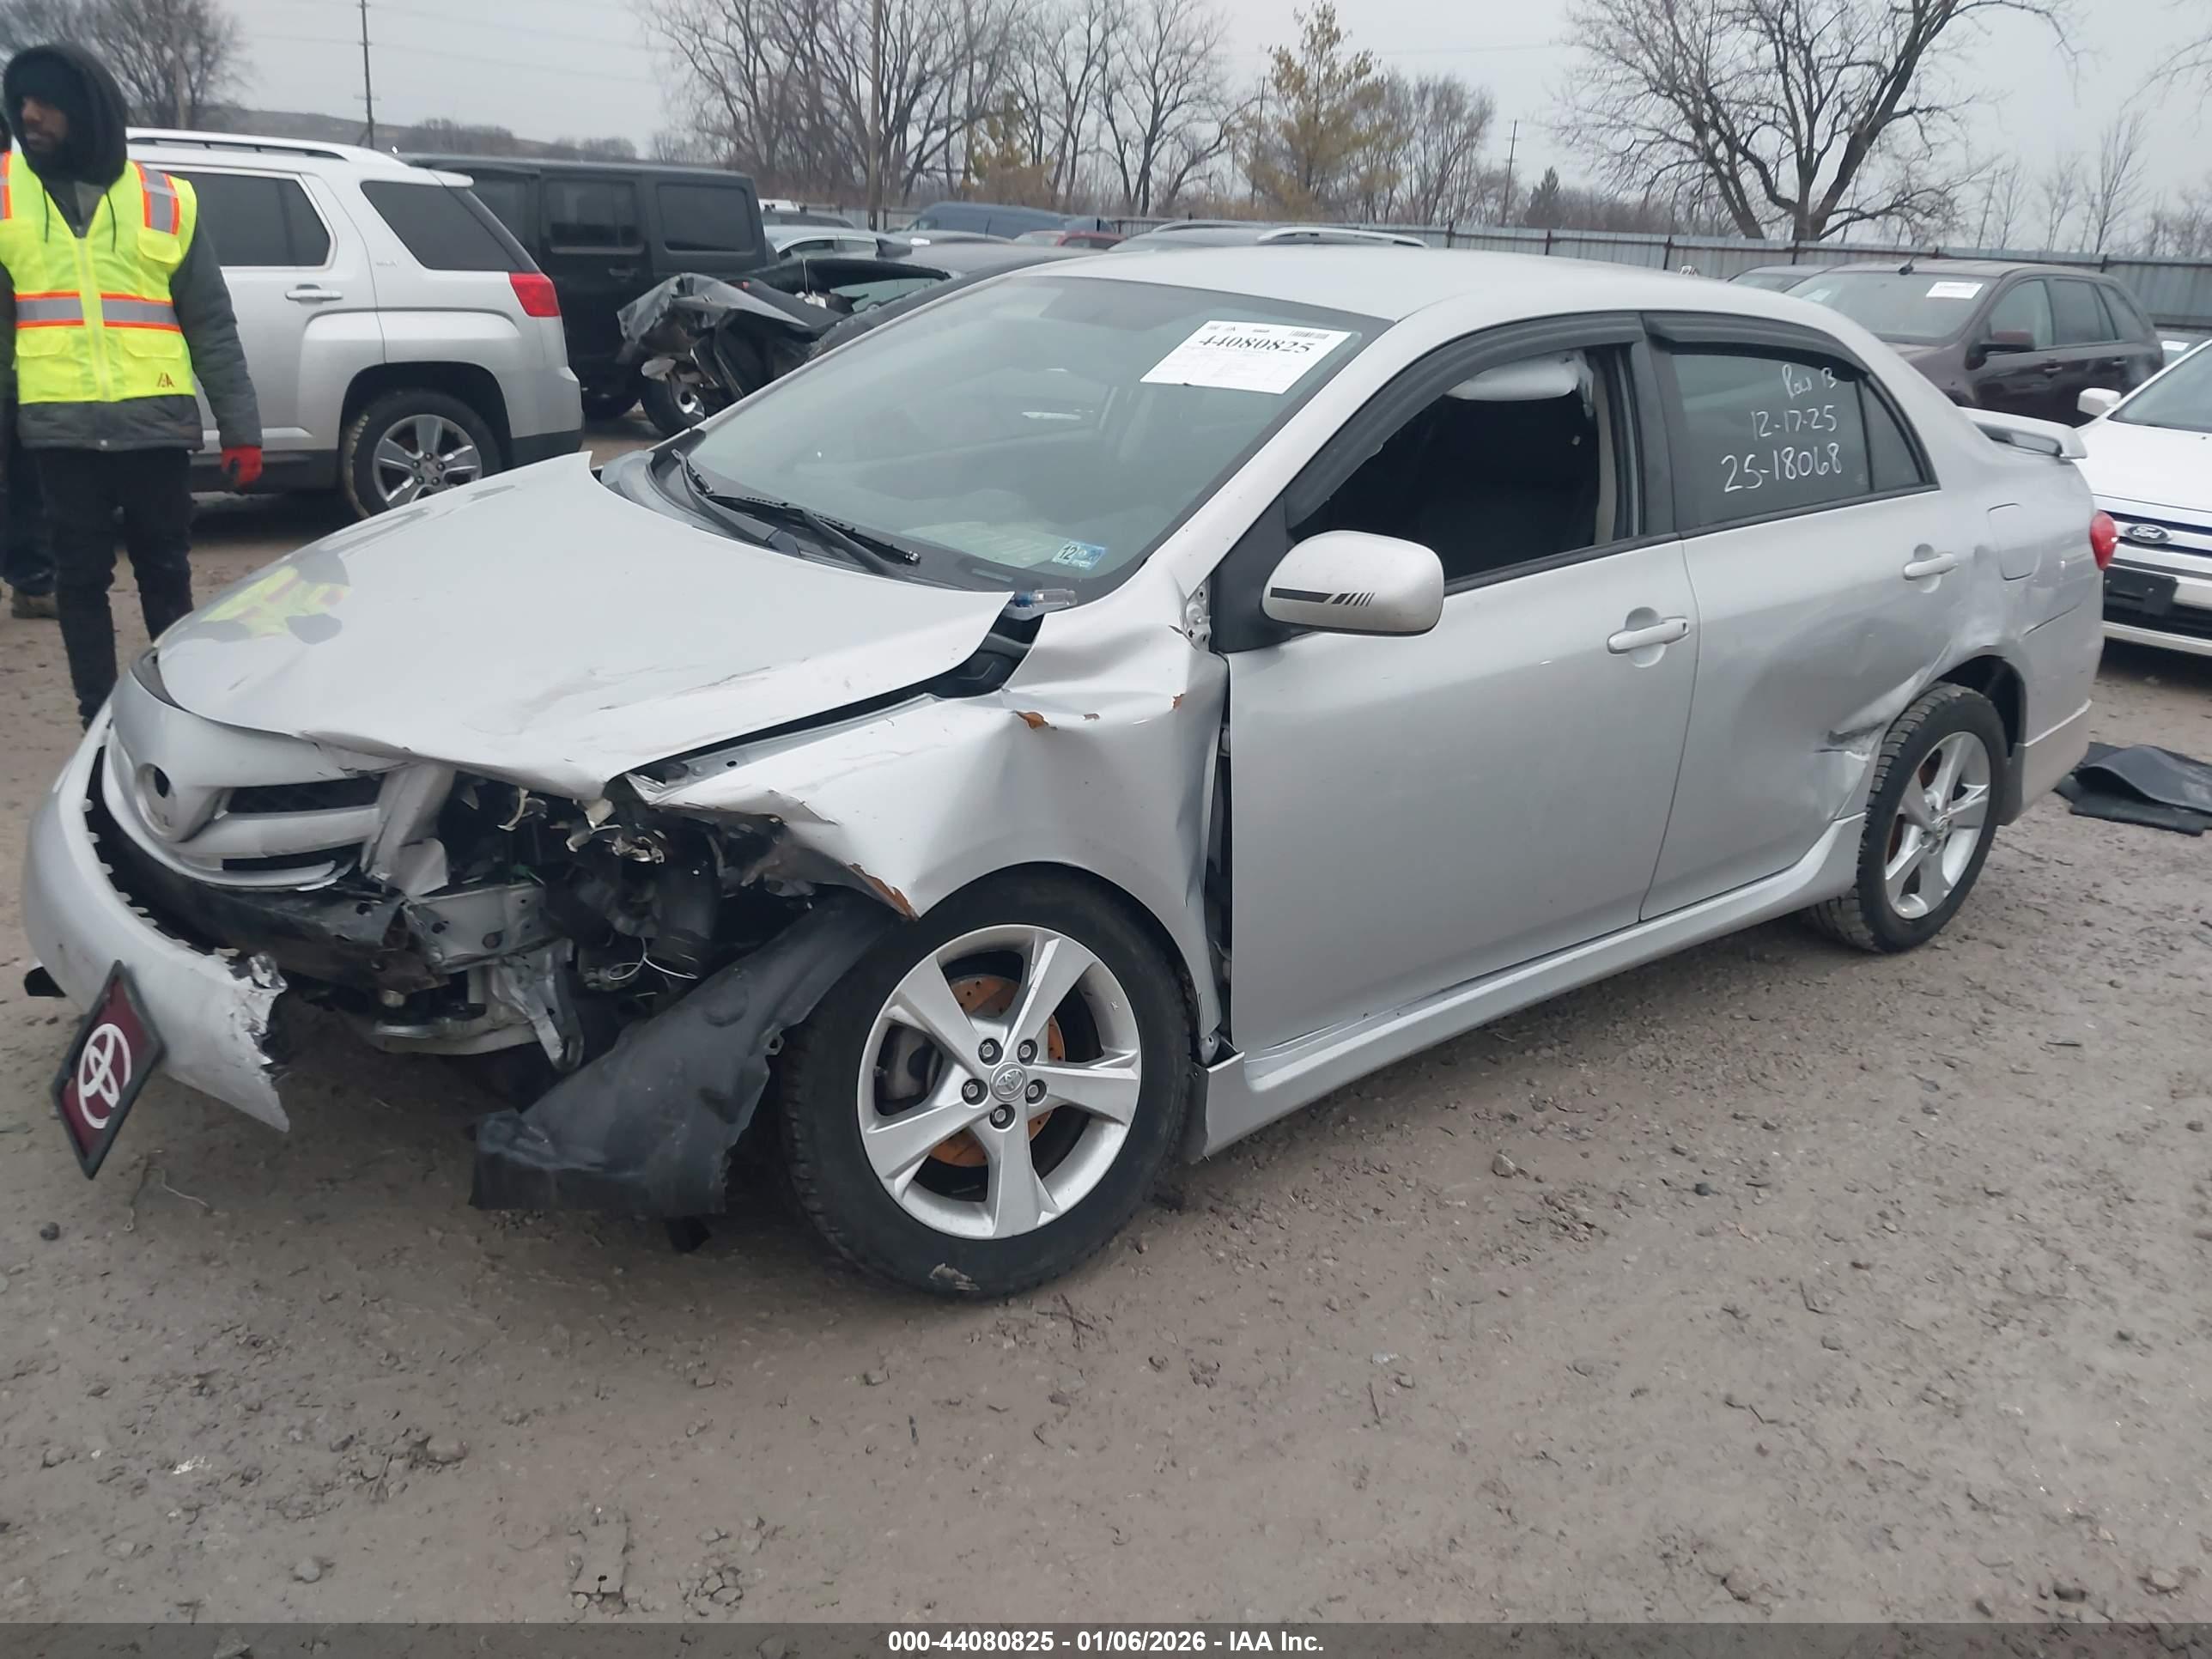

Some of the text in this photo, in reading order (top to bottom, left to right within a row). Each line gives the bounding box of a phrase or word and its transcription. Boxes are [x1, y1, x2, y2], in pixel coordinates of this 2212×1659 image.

[1199, 335, 1316, 353] 44080825
[1720, 441, 1843, 494] 25-18068
[1059, 545, 1078, 560] 12
